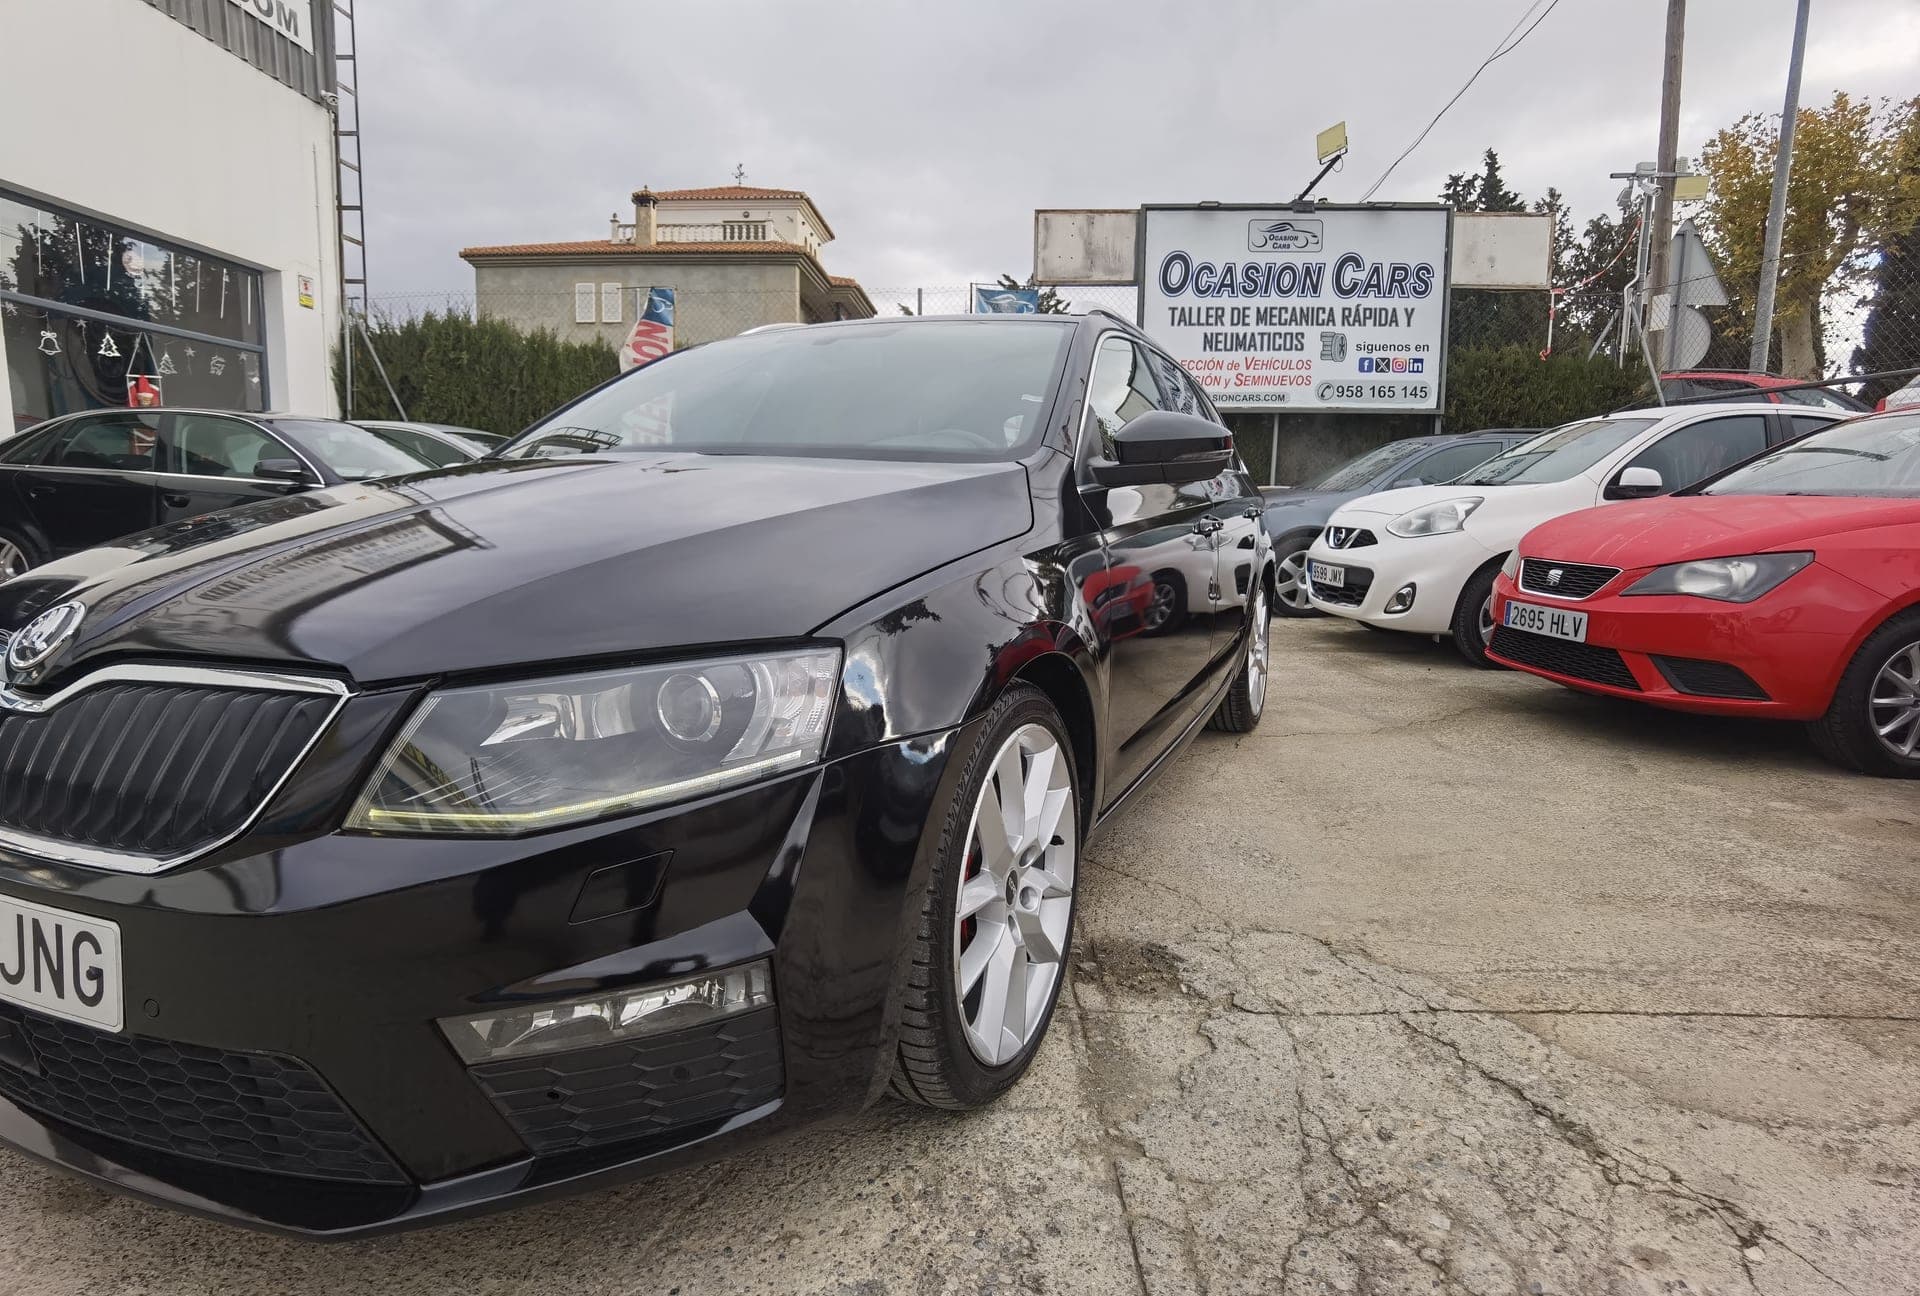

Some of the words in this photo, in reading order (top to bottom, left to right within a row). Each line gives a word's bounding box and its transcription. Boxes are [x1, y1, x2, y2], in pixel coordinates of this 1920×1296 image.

[243, 0, 300, 38] OM
[1268, 233, 1298, 241] OCASION
[1159, 250, 1326, 297] OCASION
[1332, 252, 1434, 299] CARS
[1168, 306, 1225, 327] TALLER
[1230, 306, 1251, 327] DE
[1256, 306, 1336, 327] MECANICA
[1341, 304, 1399, 327] RÁPIDA
[1404, 307, 1415, 327] Y
[1203, 331, 1305, 352] NEUMATICOS
[1414, 343, 1430, 352] en
[1227, 359, 1240, 370] de
[1244, 356, 1312, 370] VEHÍCULOS
[1223, 378, 1232, 389] y
[1233, 373, 1312, 387] SEMINUEVOS
[1209, 394, 1286, 402] SIONCARS.COM
[1336, 385, 1363, 398] 958
[1369, 385, 1396, 399] 165
[1401, 386, 1428, 399] 145
[1512, 606, 1545, 631] 2695
[1550, 613, 1582, 638] HLV
[0, 913, 104, 1008] JNG
